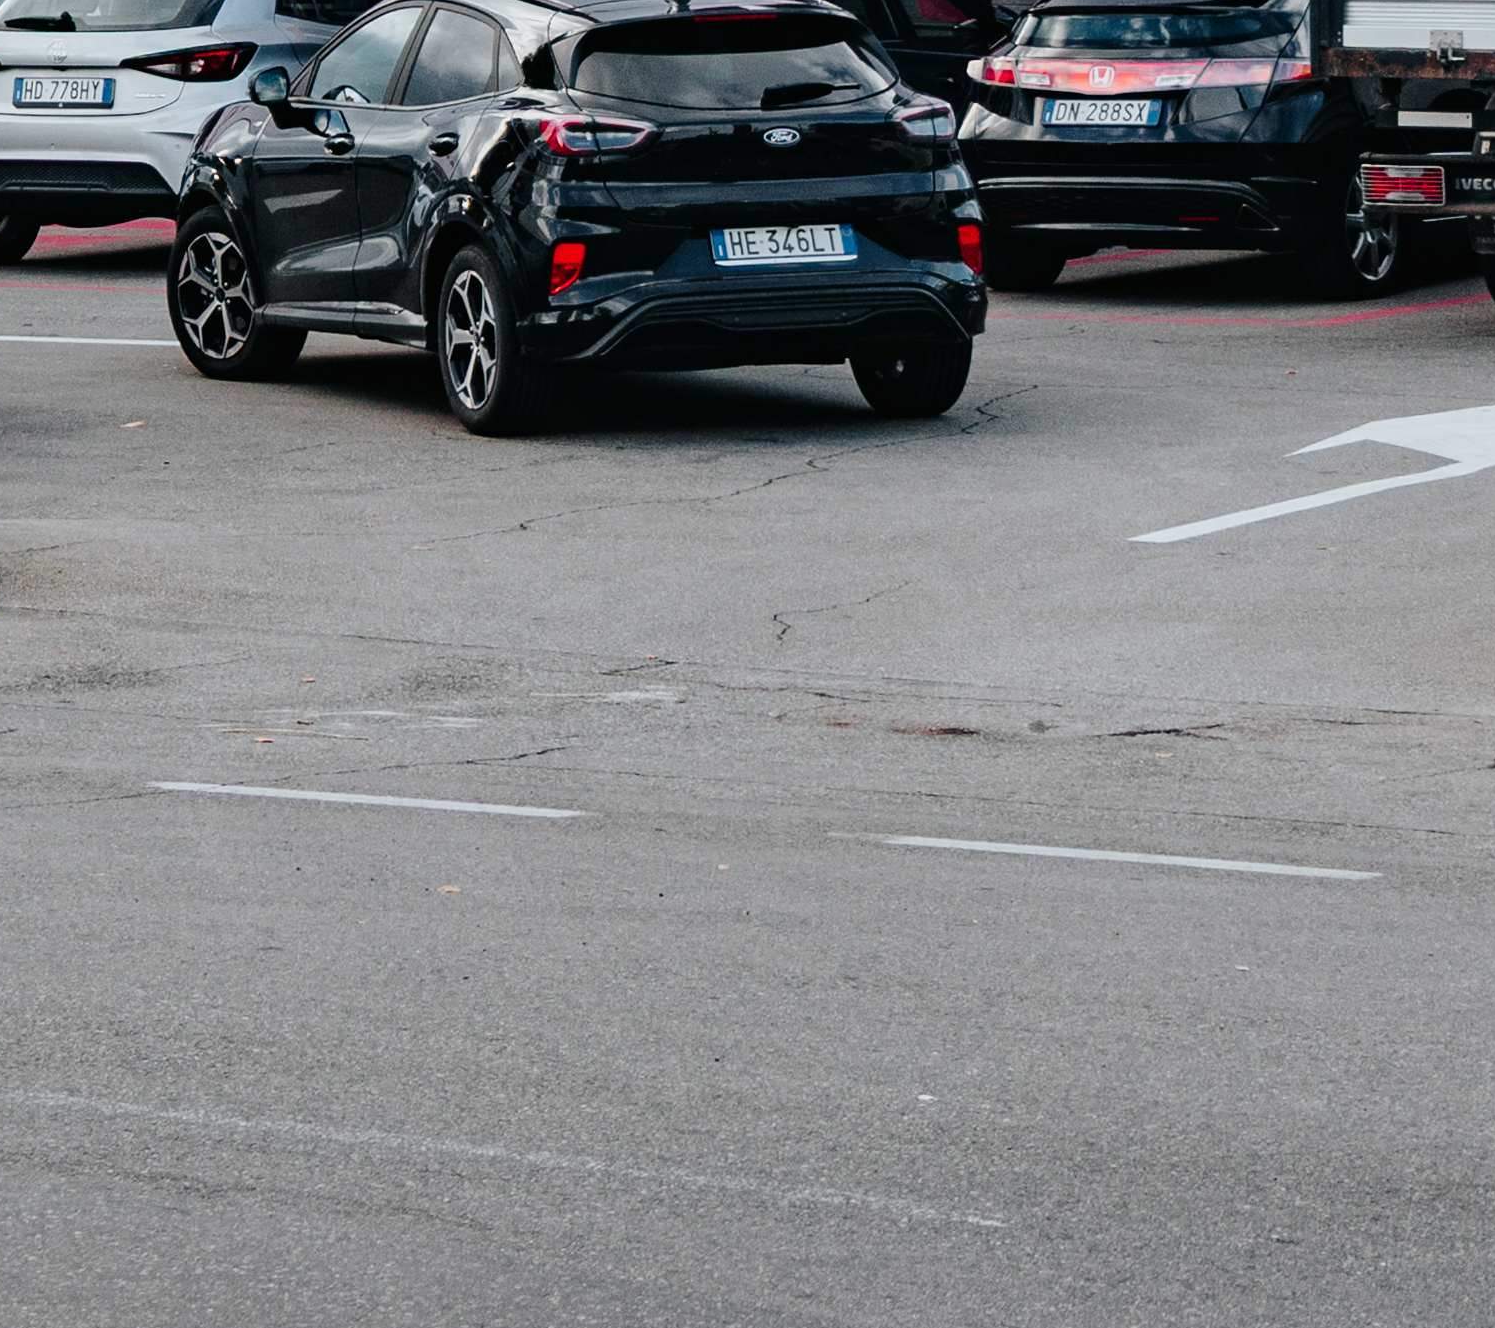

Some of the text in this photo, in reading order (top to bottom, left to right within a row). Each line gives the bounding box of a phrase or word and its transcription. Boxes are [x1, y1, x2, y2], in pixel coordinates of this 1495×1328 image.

[24, 80, 100, 100] HD 778HY
[1056, 103, 1080, 121] DN
[1086, 103, 1146, 121] 288SX
[729, 231, 759, 257] HE
[766, 227, 837, 255] 346LT
